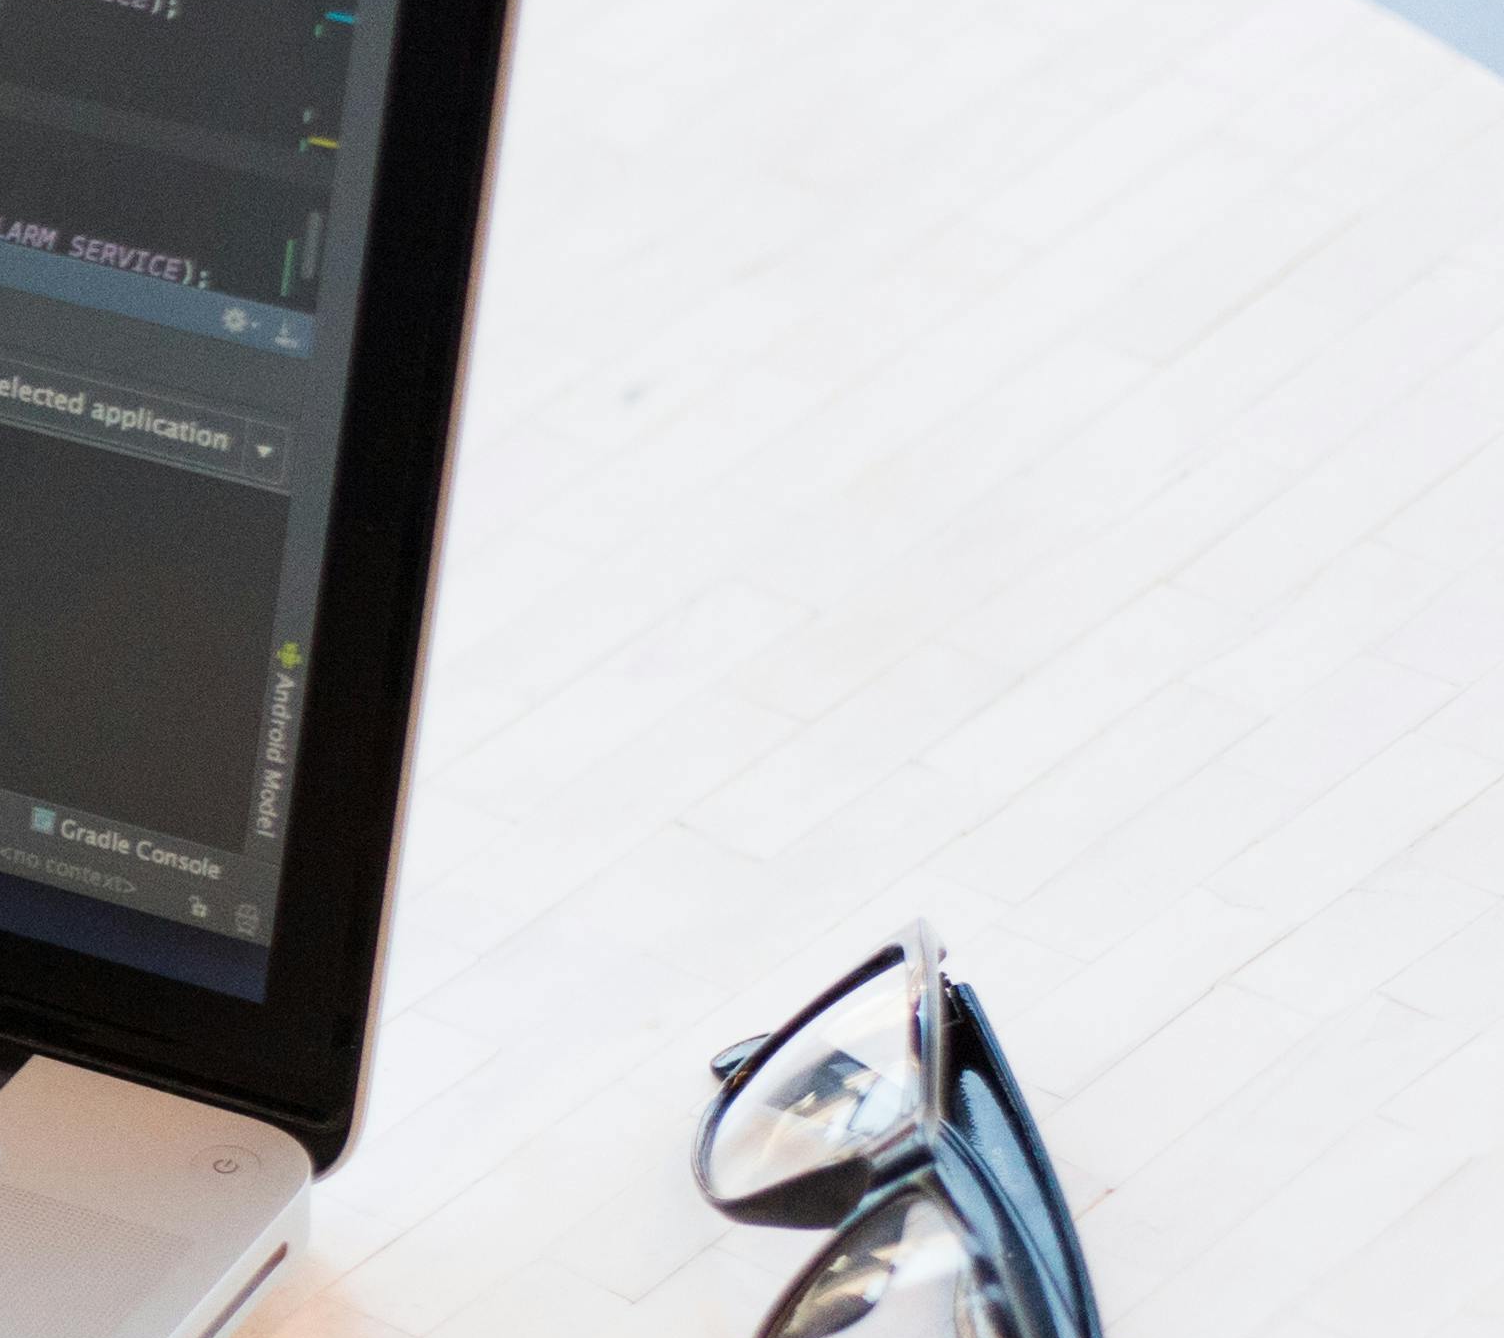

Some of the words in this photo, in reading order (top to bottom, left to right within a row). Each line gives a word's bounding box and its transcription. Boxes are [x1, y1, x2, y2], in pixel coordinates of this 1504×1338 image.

[89, 401, 231, 451] application
[265, 671, 294, 764] Android
[256, 767, 283, 838] Model
[59, 819, 132, 855] Gradle
[138, 841, 222, 881] Console
